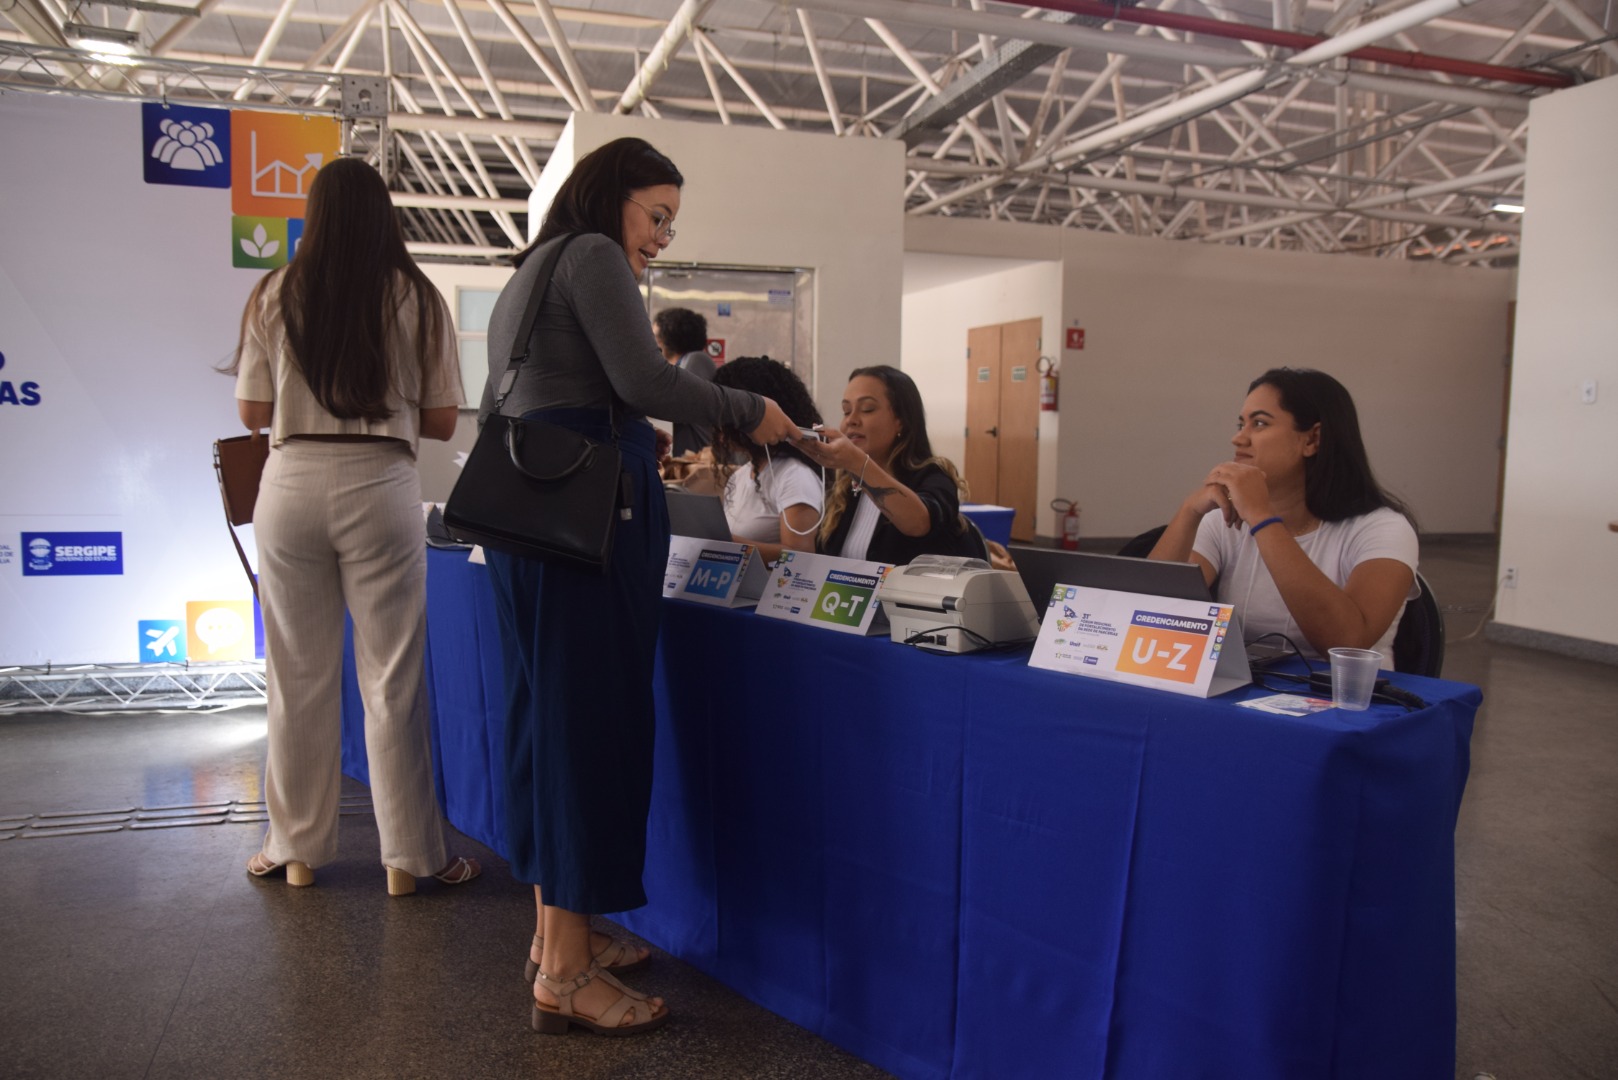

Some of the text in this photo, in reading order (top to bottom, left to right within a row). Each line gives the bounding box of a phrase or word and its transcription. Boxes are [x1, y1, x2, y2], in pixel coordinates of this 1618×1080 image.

[54, 546, 117, 557] SERGIPE
[701, 551, 740, 562] CREDENCIAMENTO
[690, 567, 731, 590] M-P
[829, 573, 876, 586] CREDENCIAMENTO
[821, 591, 864, 617] Q-T
[1135, 614, 1208, 631] CREDENCIAMENTO
[1131, 637, 1193, 671] U-Z
